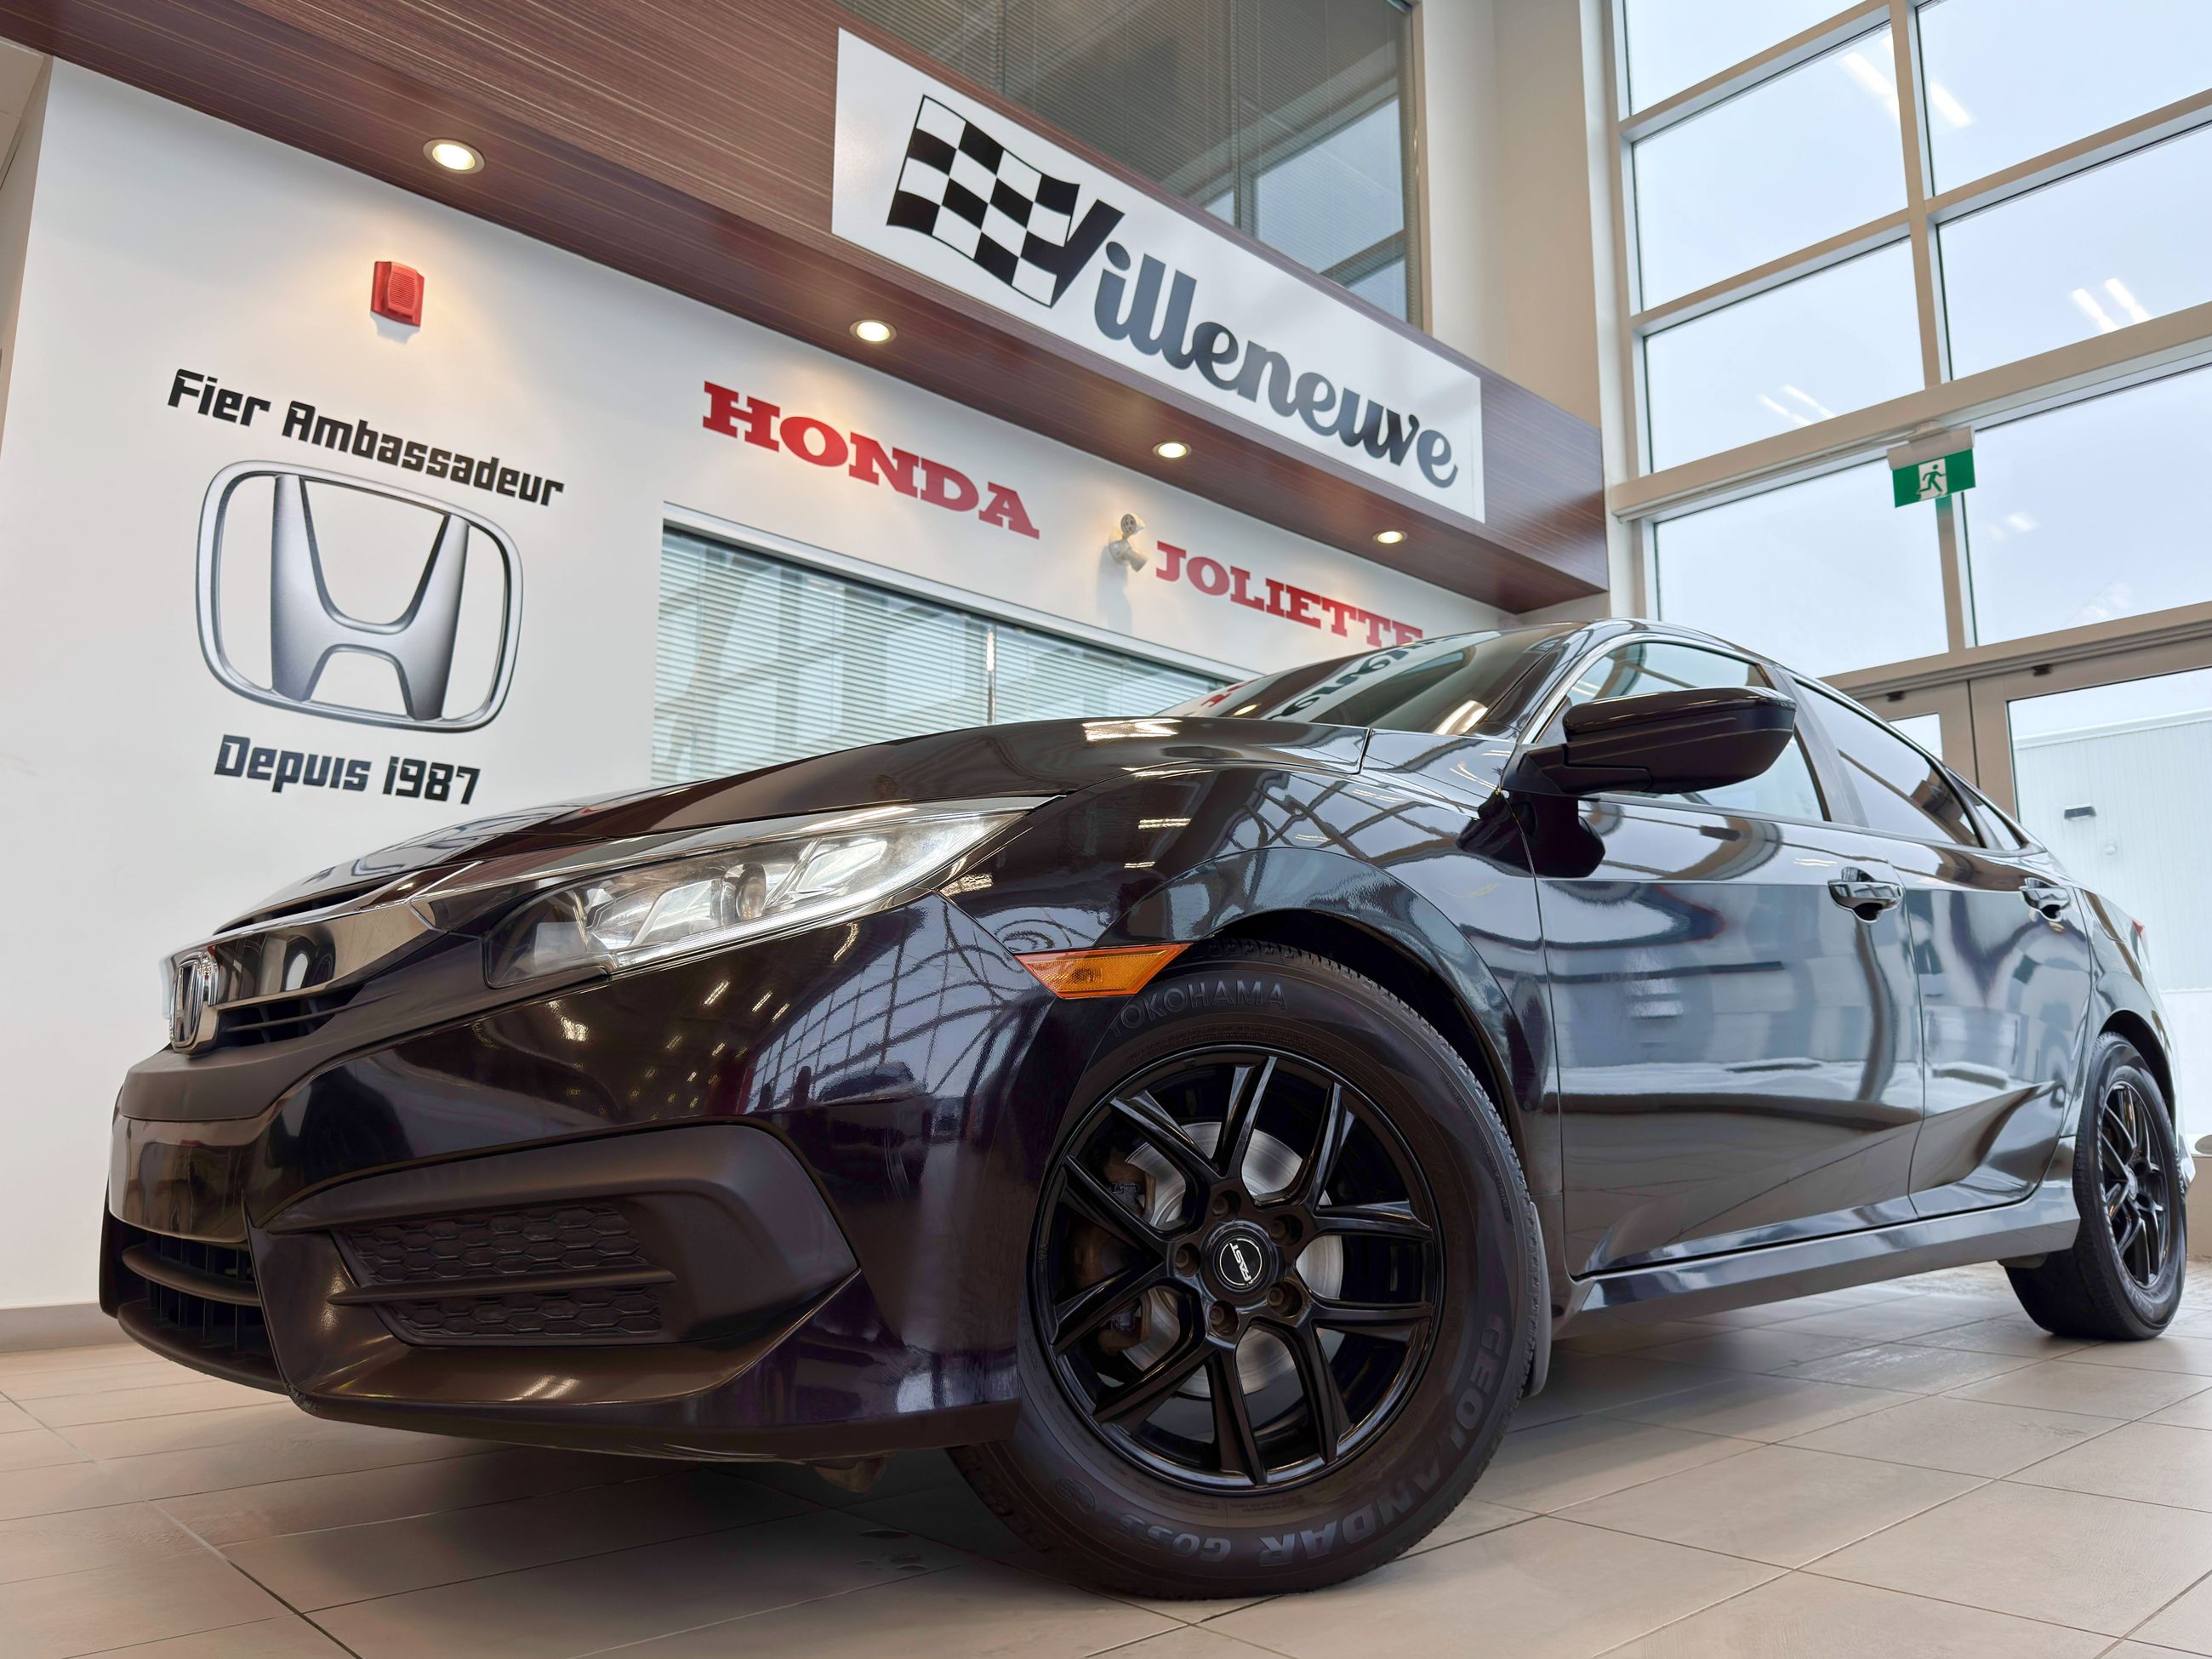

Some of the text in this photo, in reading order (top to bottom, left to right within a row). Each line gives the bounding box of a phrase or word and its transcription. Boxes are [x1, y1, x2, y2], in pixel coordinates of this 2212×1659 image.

[1017, 199, 1458, 487] Villeneuve
[168, 368, 564, 506] Fier Ambassadeur
[703, 381, 1040, 539] HONDA
[1156, 540, 1423, 647] JOLIETTE
[214, 734, 481, 805] Depuis 1987
[1229, 1242, 1253, 1282] FAST
